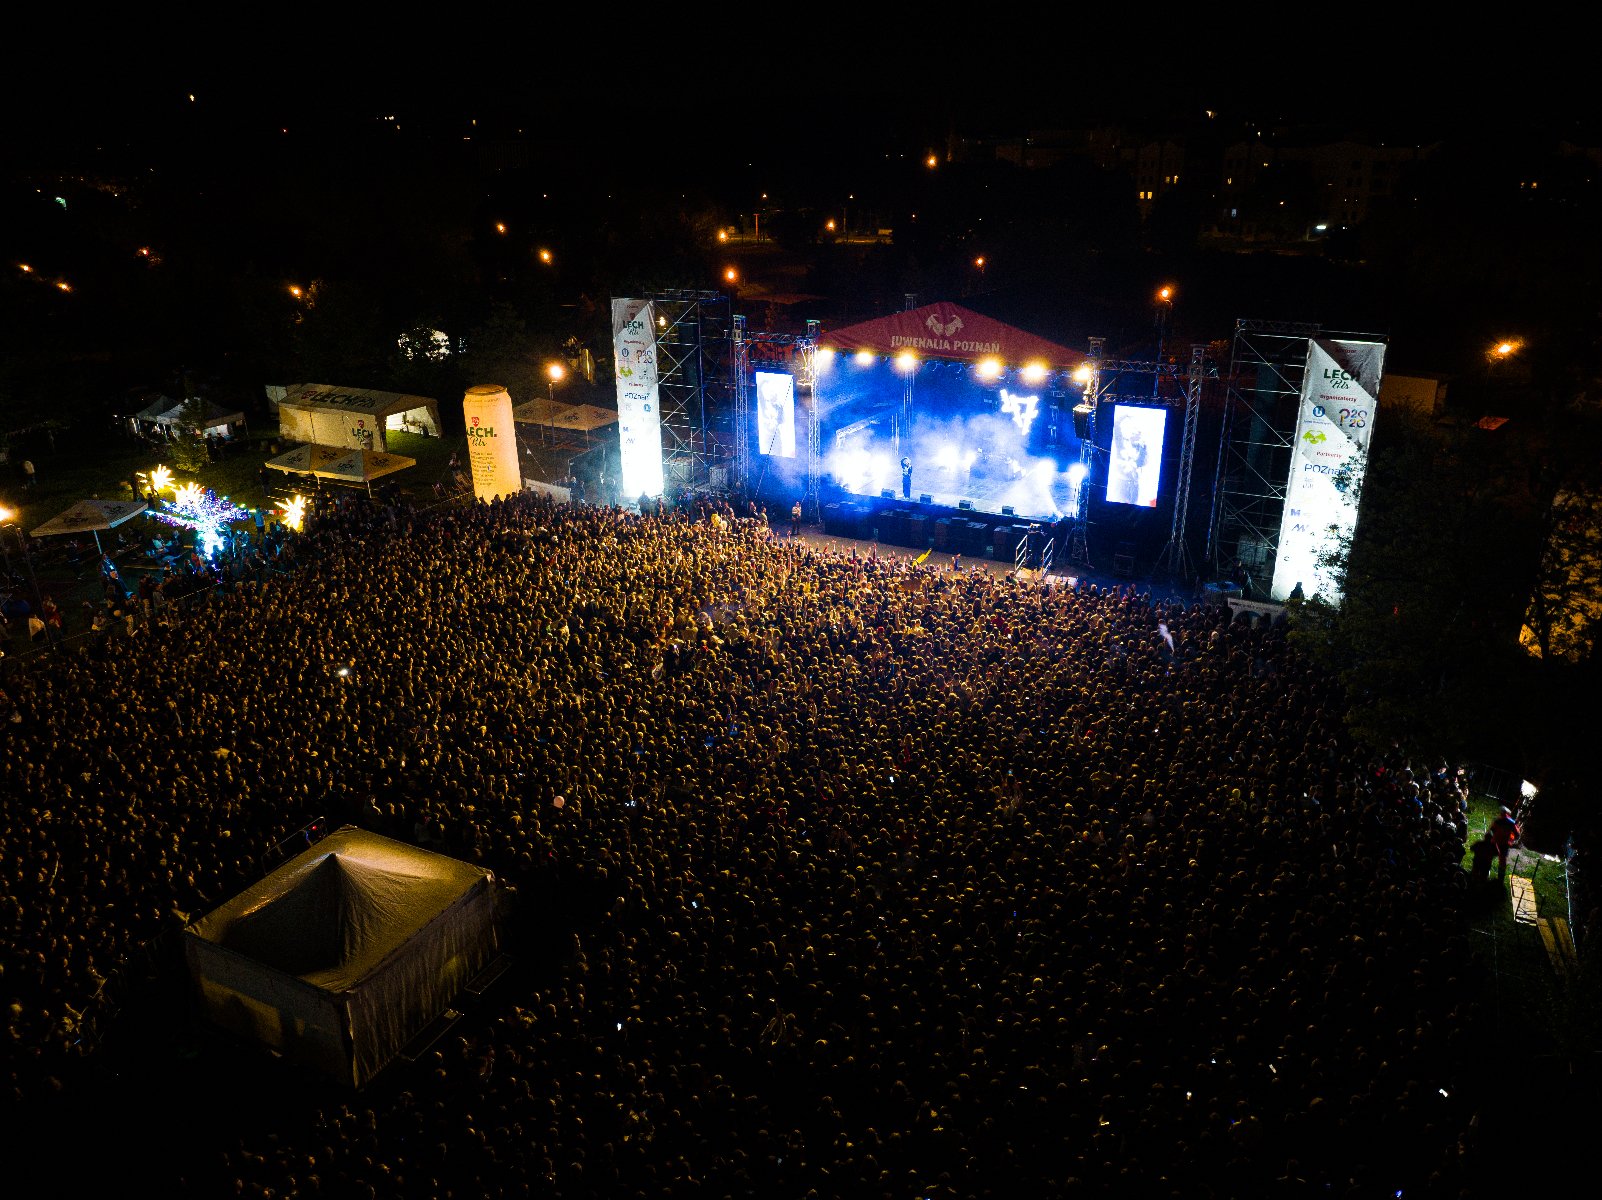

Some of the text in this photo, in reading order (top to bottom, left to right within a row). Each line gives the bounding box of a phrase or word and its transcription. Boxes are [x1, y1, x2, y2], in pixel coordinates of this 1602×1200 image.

[622, 320, 644, 329] LECH
[890, 335, 1000, 353] JUWENALIA POZNAŃ
[1323, 369, 1360, 382] LECH
[352, 428, 374, 440] LECH
